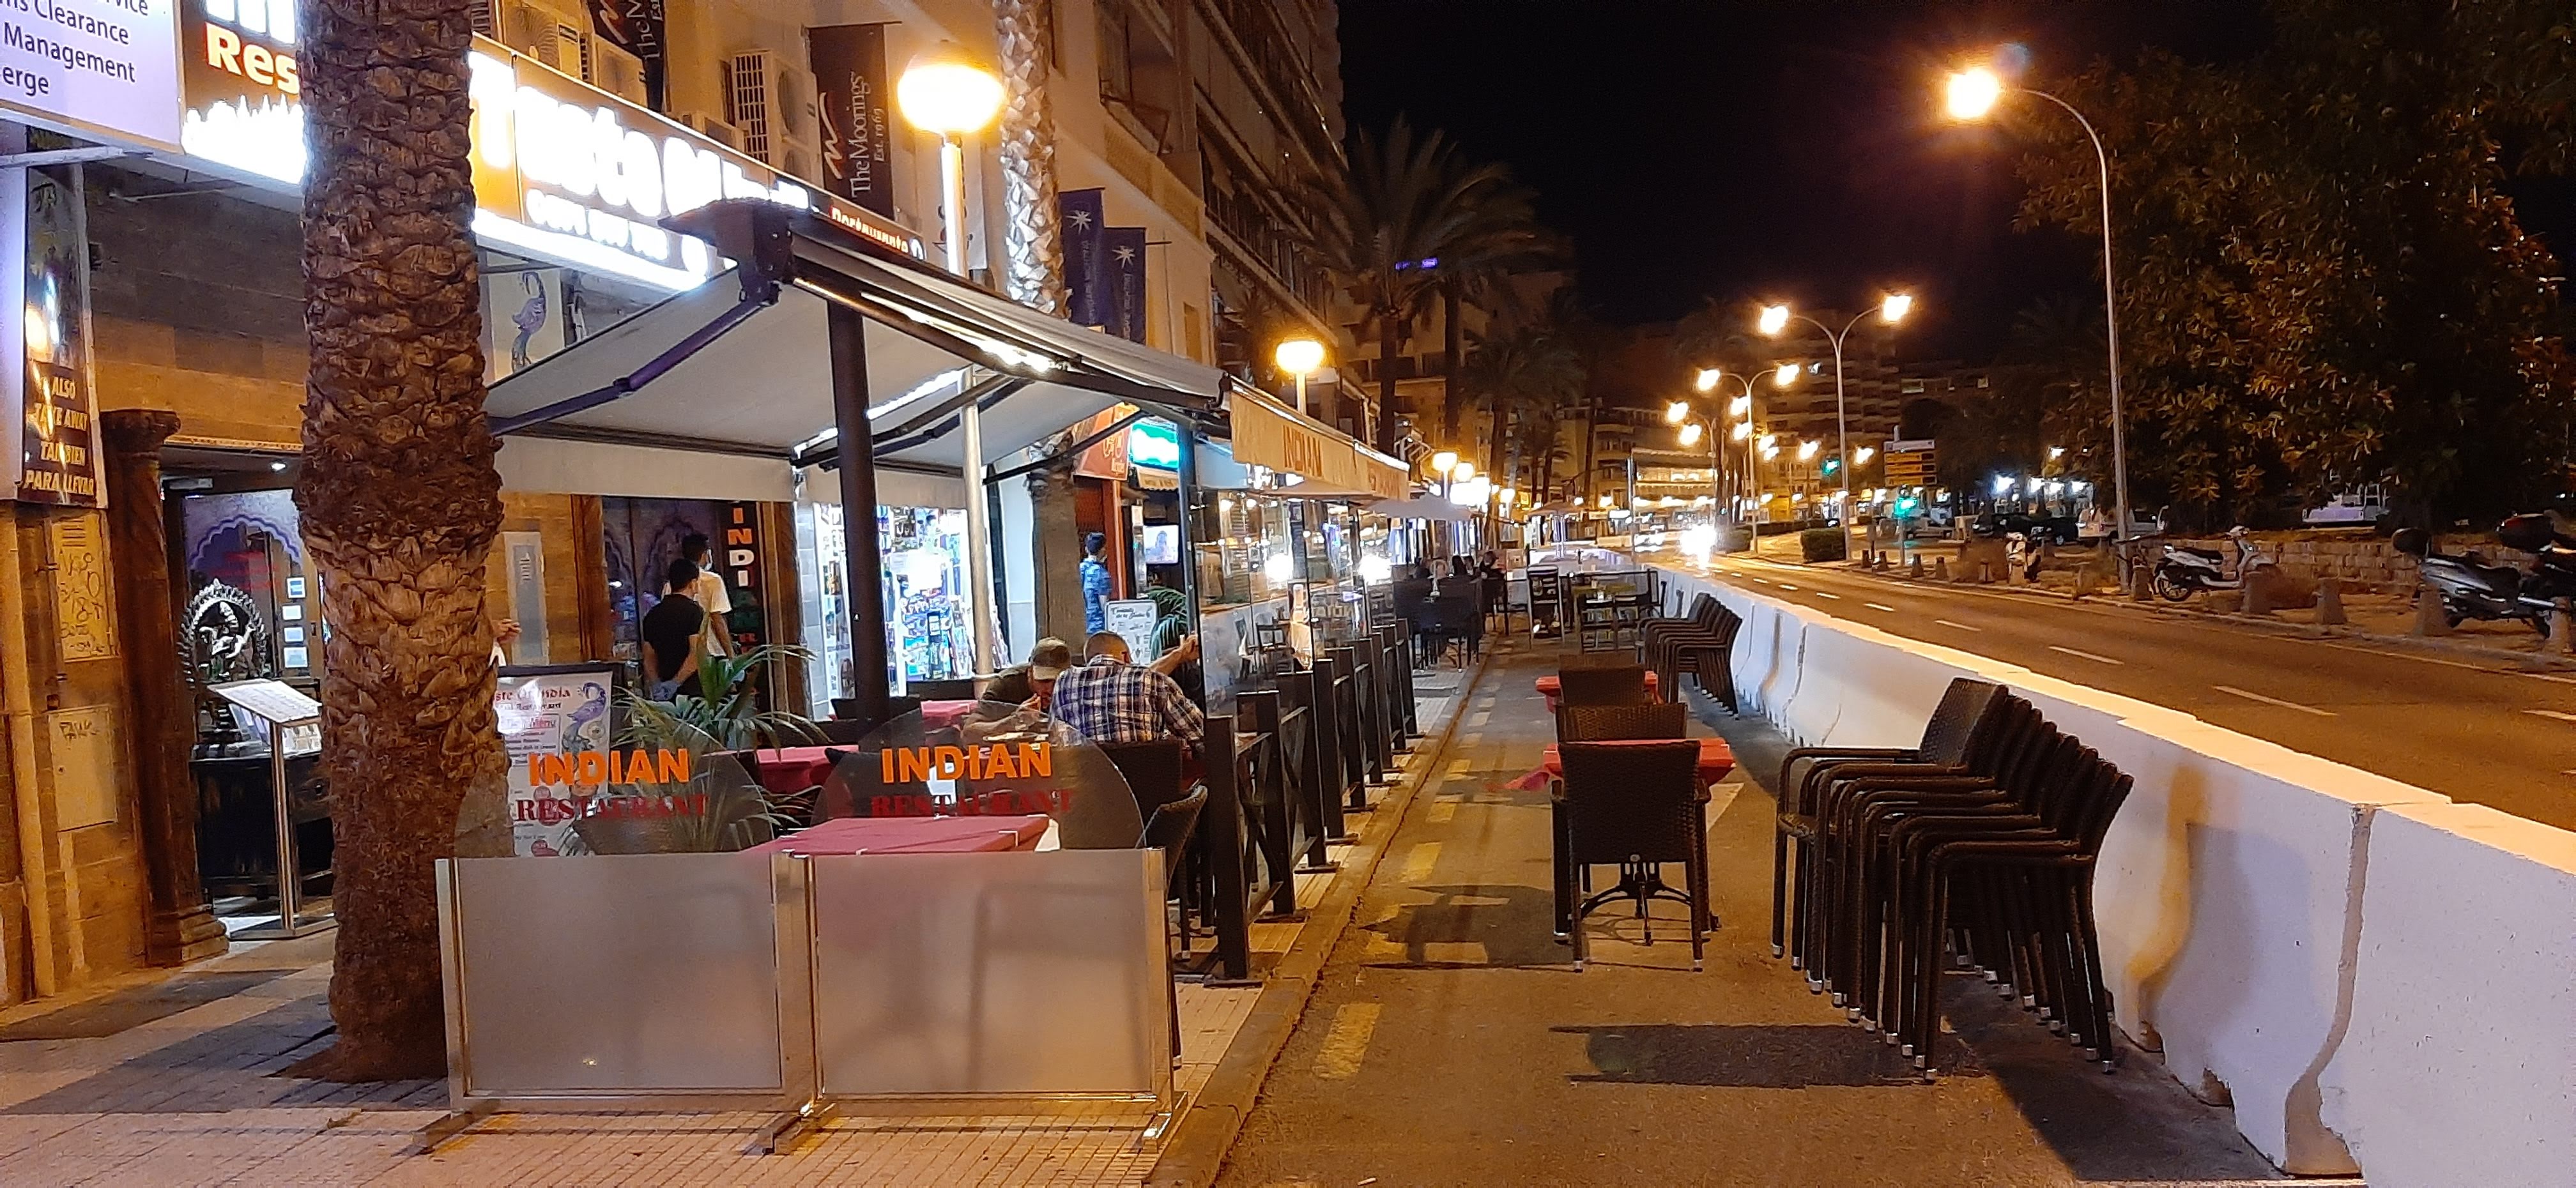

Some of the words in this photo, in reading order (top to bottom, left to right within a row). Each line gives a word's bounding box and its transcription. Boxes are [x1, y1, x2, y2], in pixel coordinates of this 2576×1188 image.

[34, 0, 129, 45] Clearance
[4, 22, 135, 82] Management
[203, 21, 300, 95] Res
[0, 66, 50, 96] erge
[846, 71, 871, 160] Moorings
[849, 160, 871, 198] The
[52, 377, 76, 400] ALSO
[64, 409, 88, 432] AWAY
[1282, 424, 1322, 477] INDIAN
[22, 469, 61, 492] PARA
[528, 748, 690, 787] INDIAN
[881, 741, 1052, 784] INDIAN
[514, 792, 709, 821] RESTAURANT
